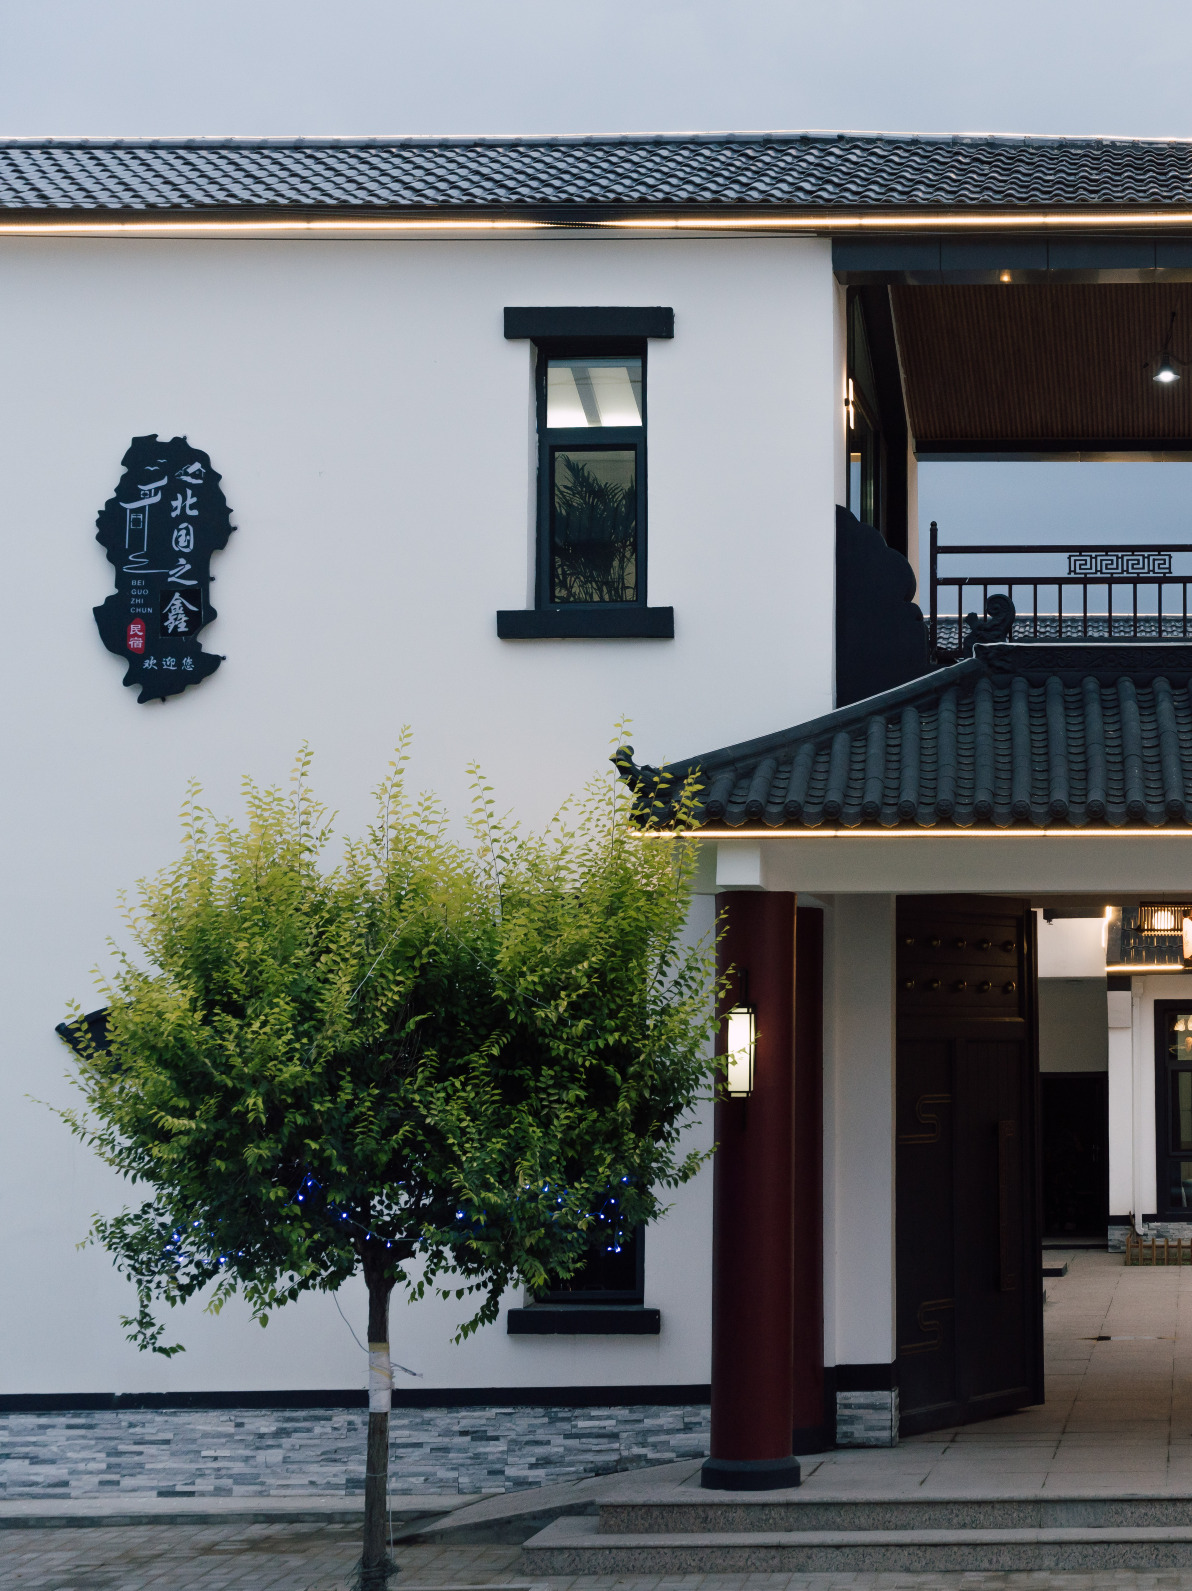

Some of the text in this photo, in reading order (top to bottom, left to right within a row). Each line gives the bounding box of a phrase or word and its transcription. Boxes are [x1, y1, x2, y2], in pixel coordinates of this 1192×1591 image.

[129, 624, 143, 649] 民宿
[143, 656, 194, 671] 欢迎您
